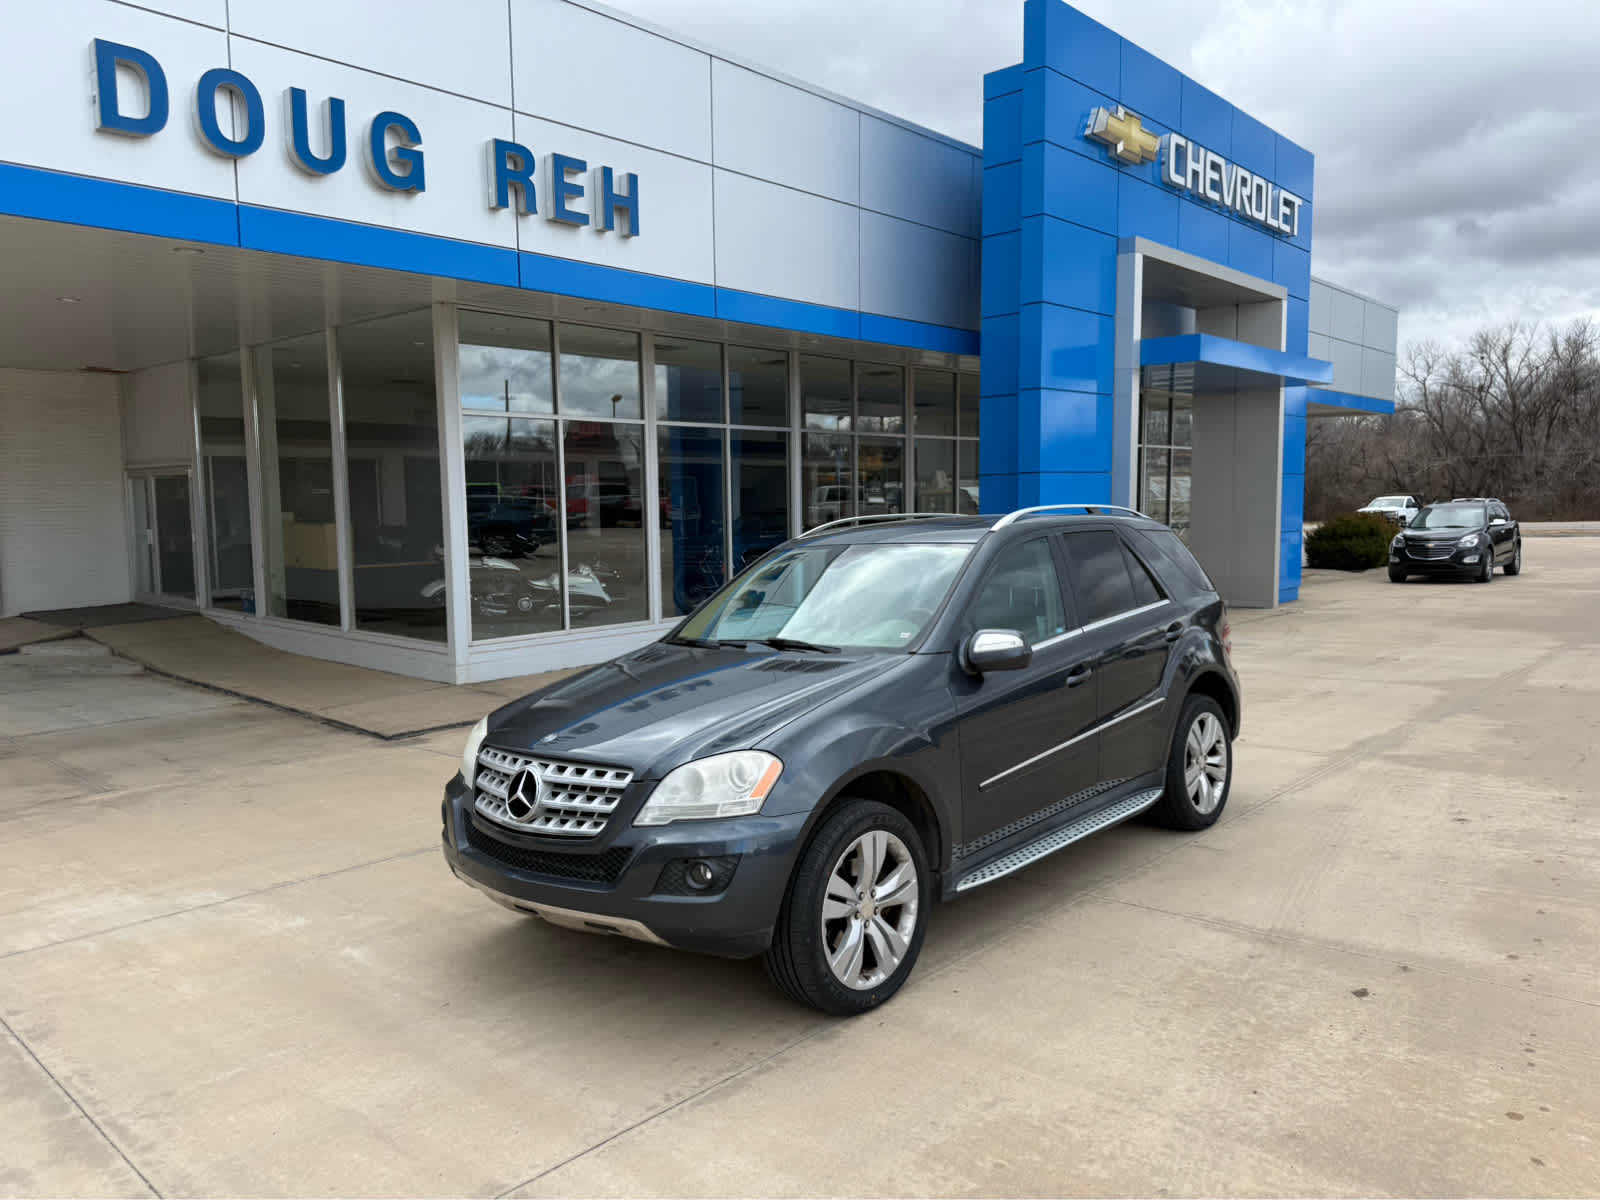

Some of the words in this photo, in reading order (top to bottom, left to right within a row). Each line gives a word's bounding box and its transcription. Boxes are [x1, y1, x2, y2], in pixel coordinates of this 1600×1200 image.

[92, 38, 426, 194] DOUG
[489, 138, 640, 237] REH
[1164, 133, 1302, 237] CHEVROLET
